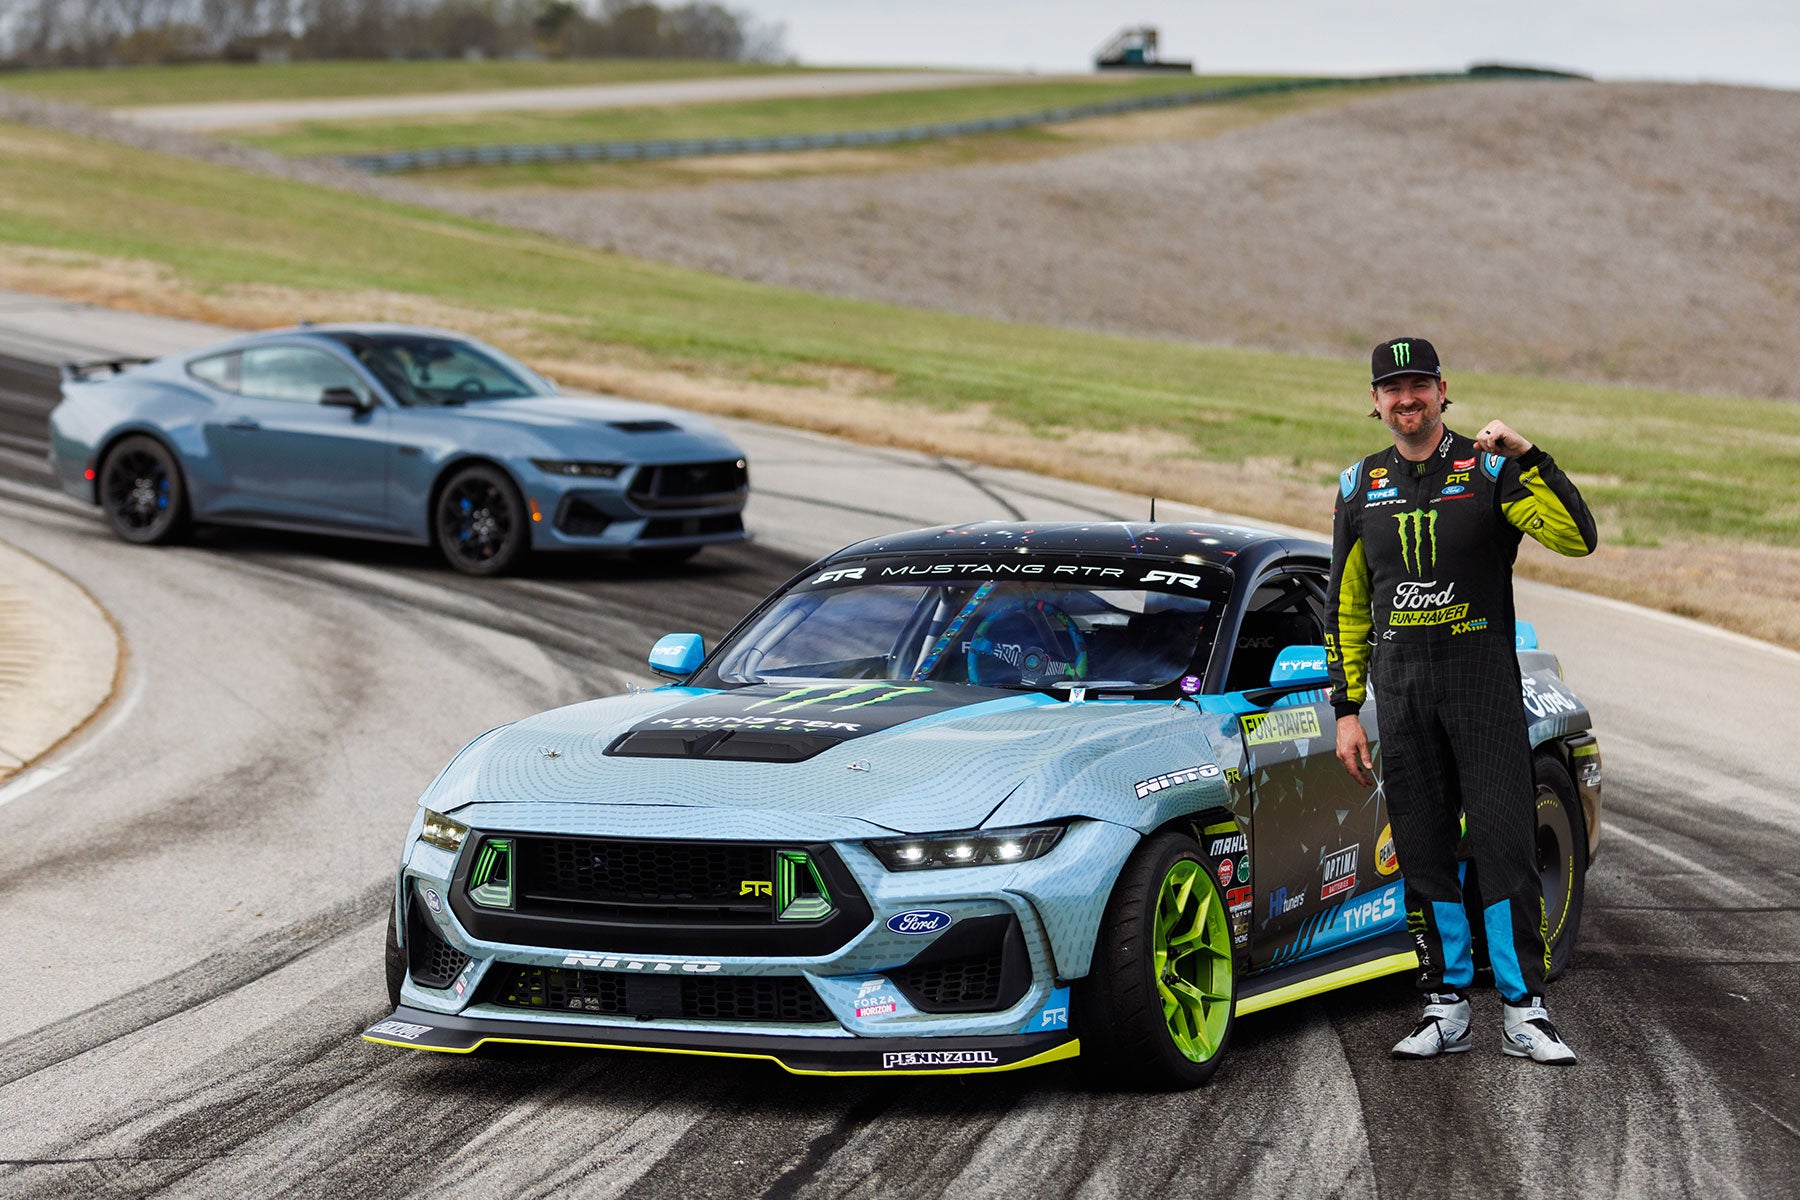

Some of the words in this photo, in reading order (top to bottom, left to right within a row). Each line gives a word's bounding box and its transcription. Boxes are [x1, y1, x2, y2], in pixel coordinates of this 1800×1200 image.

[881, 564, 1045, 576] MUSTANG
[1054, 563, 1125, 578] RTR
[1393, 580, 1455, 609] Ford
[1391, 605, 1466, 624] FUN-HAVER
[1280, 661, 1327, 671] TYPE
[1245, 711, 1319, 739] FUN-HAVER
[1134, 763, 1220, 800] NITTO
[1325, 850, 1356, 881] OPTIMA
[900, 910, 940, 932] Ford
[562, 953, 721, 973] NITTO
[854, 995, 895, 1007] FORZA
[860, 1003, 893, 1017] HORIZON
[883, 1051, 998, 1068] PENNZOIL
